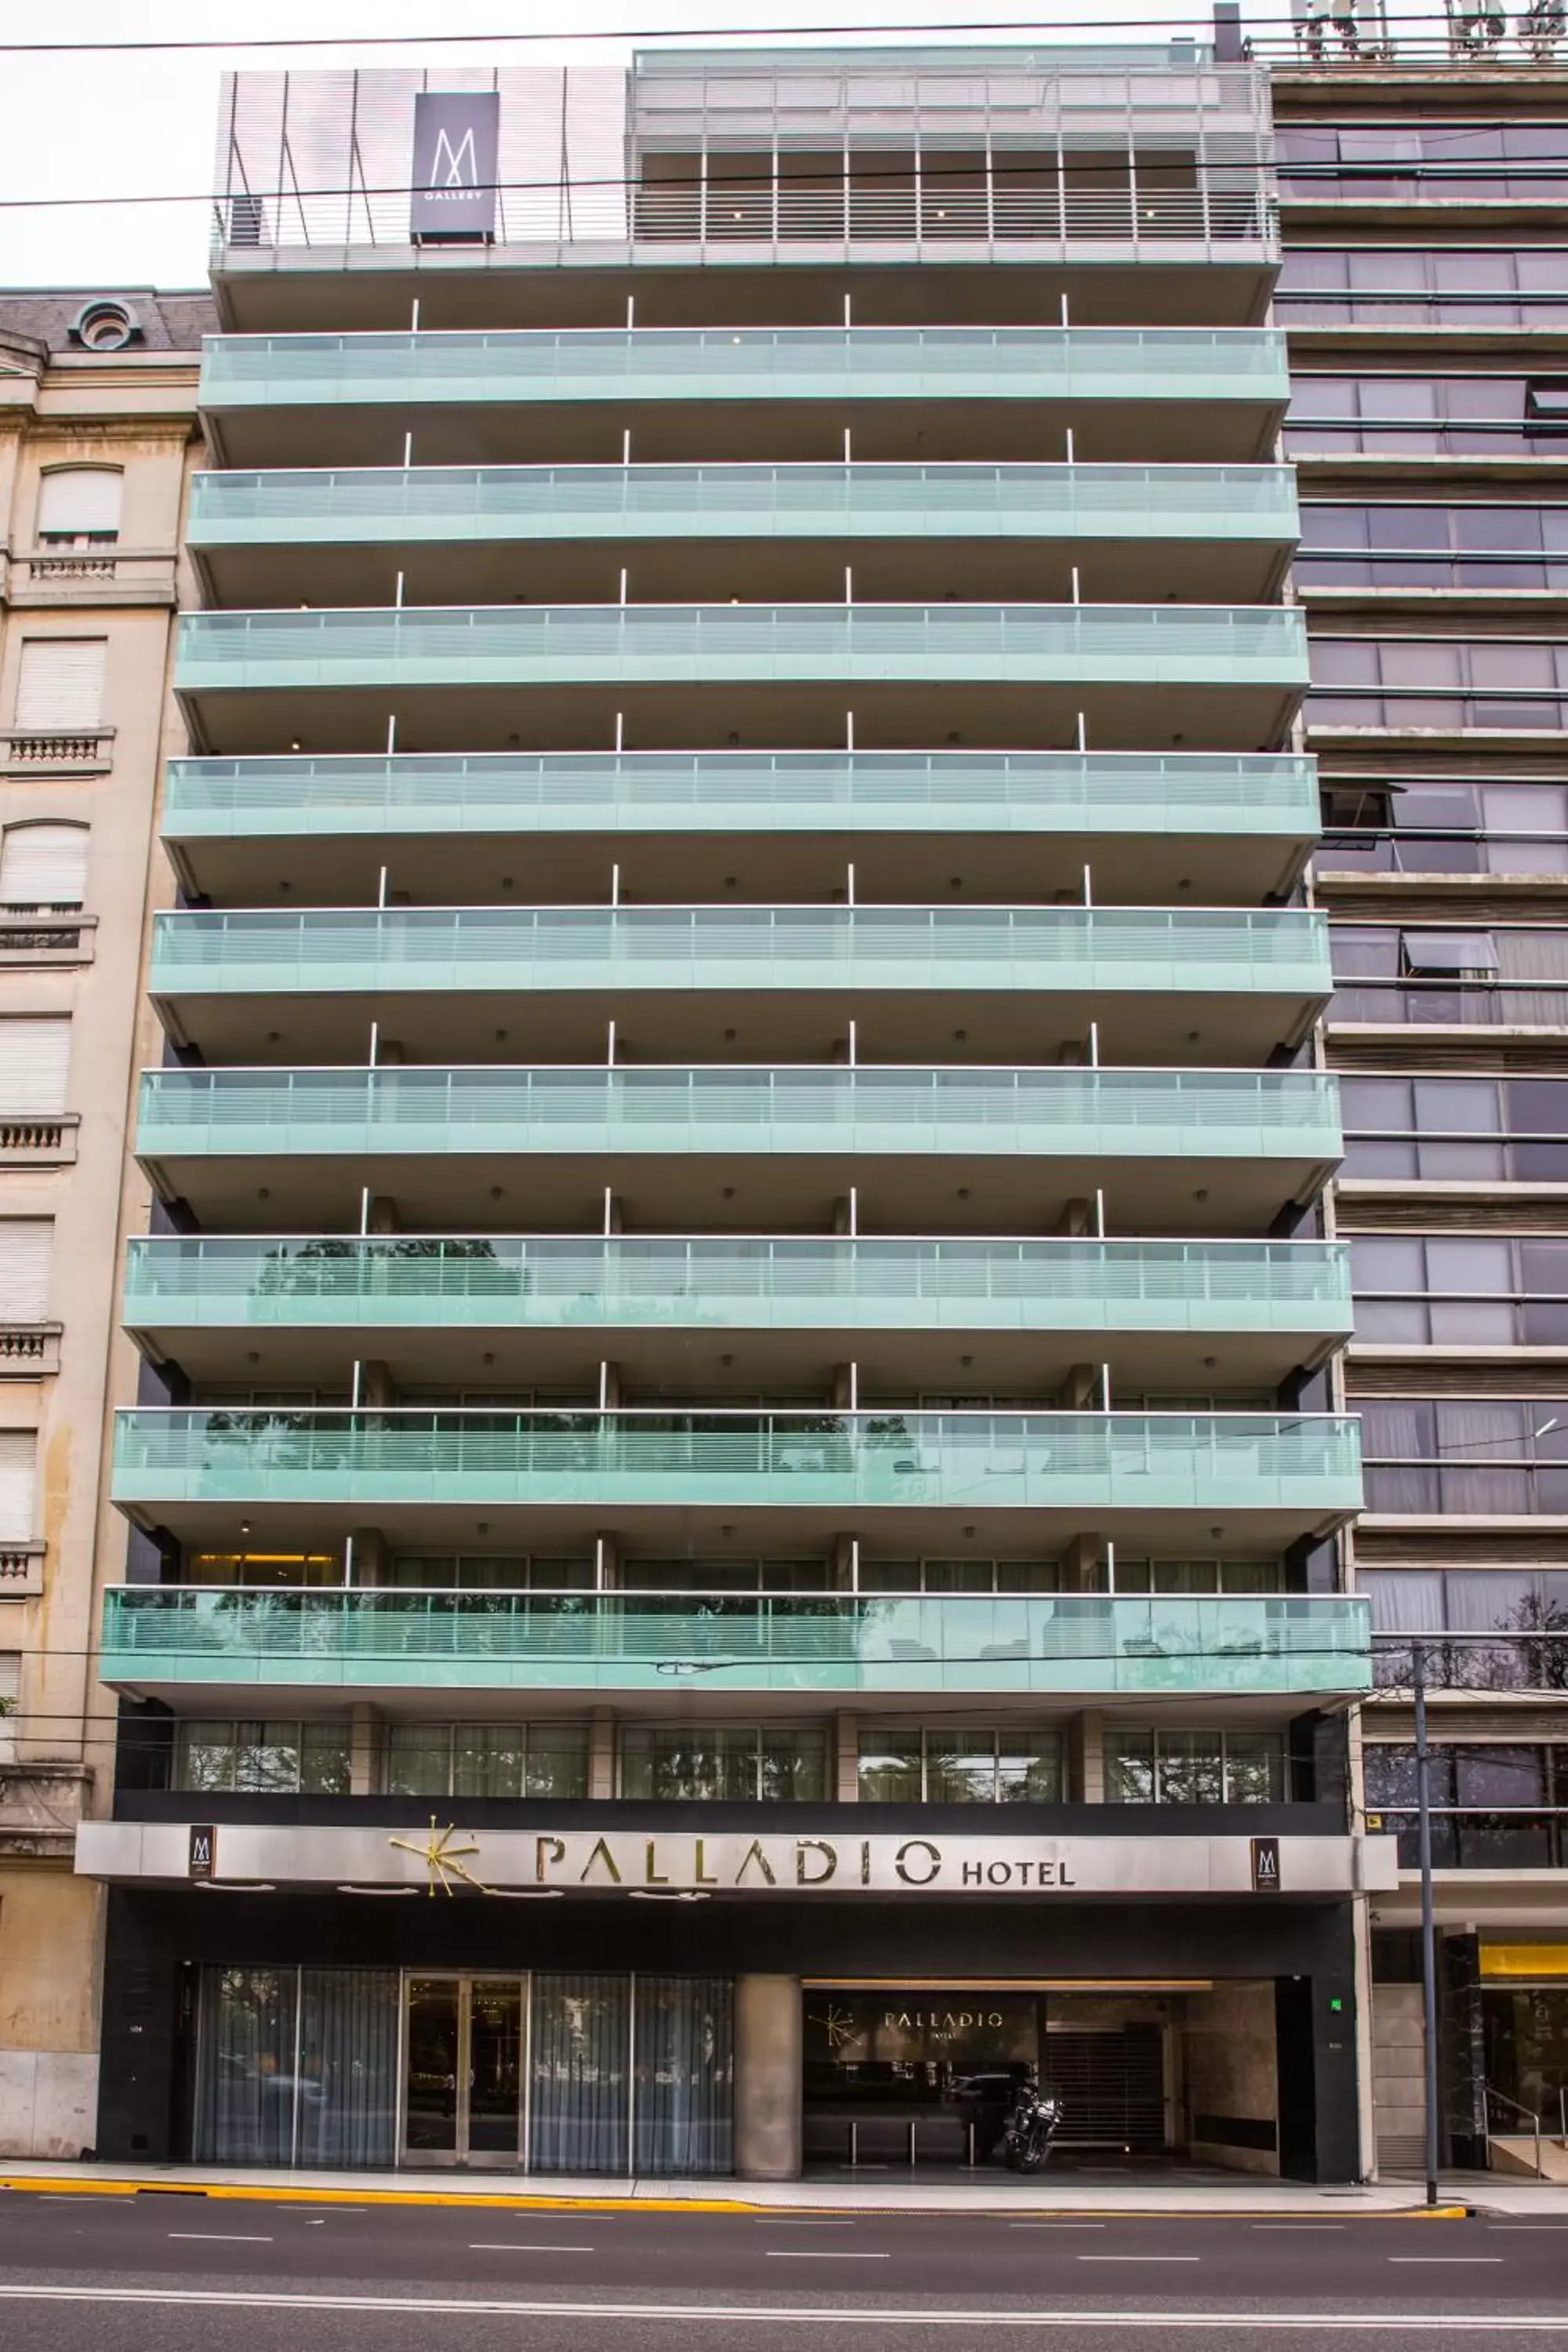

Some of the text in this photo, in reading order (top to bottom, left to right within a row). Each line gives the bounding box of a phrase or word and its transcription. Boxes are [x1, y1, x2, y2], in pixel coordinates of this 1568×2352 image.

[424, 191, 482, 201] GALLERY
[535, 1836, 1076, 1886] PALLADIO HOTEL
[884, 2013, 1004, 2027] PALLADIO
